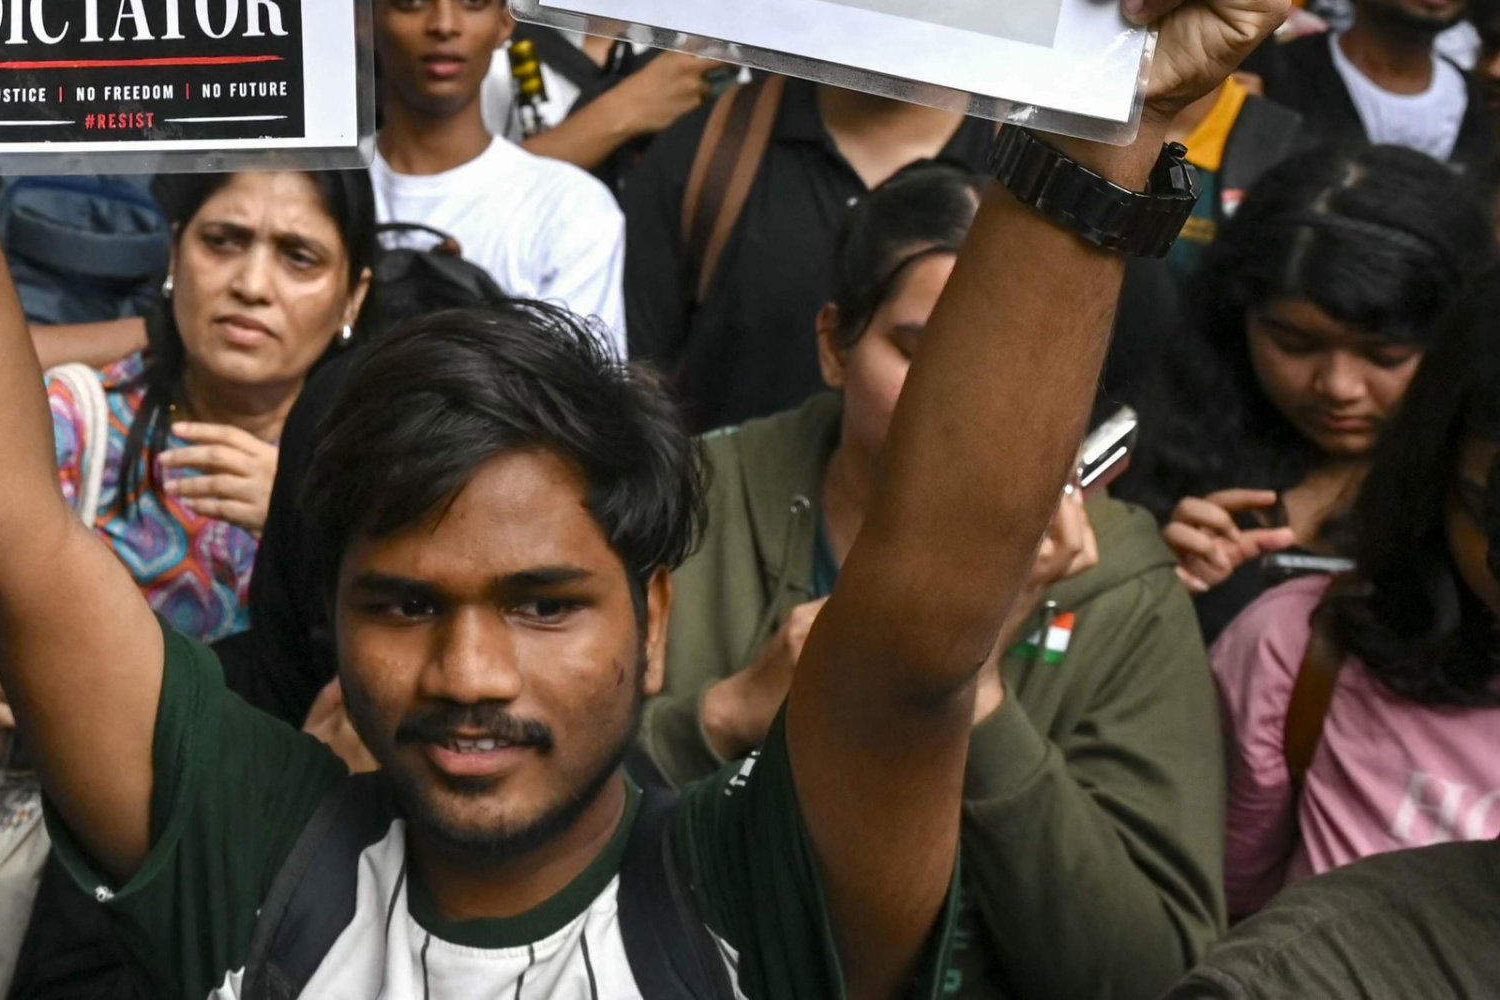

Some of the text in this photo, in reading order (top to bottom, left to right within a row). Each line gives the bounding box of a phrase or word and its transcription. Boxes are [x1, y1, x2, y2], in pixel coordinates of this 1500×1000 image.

[76, 86, 95, 101] NO
[105, 85, 173, 100] FREEDOM
[202, 84, 220, 98] NO
[230, 82, 287, 97] FUTURE
[85, 113, 155, 128] #RESIST
